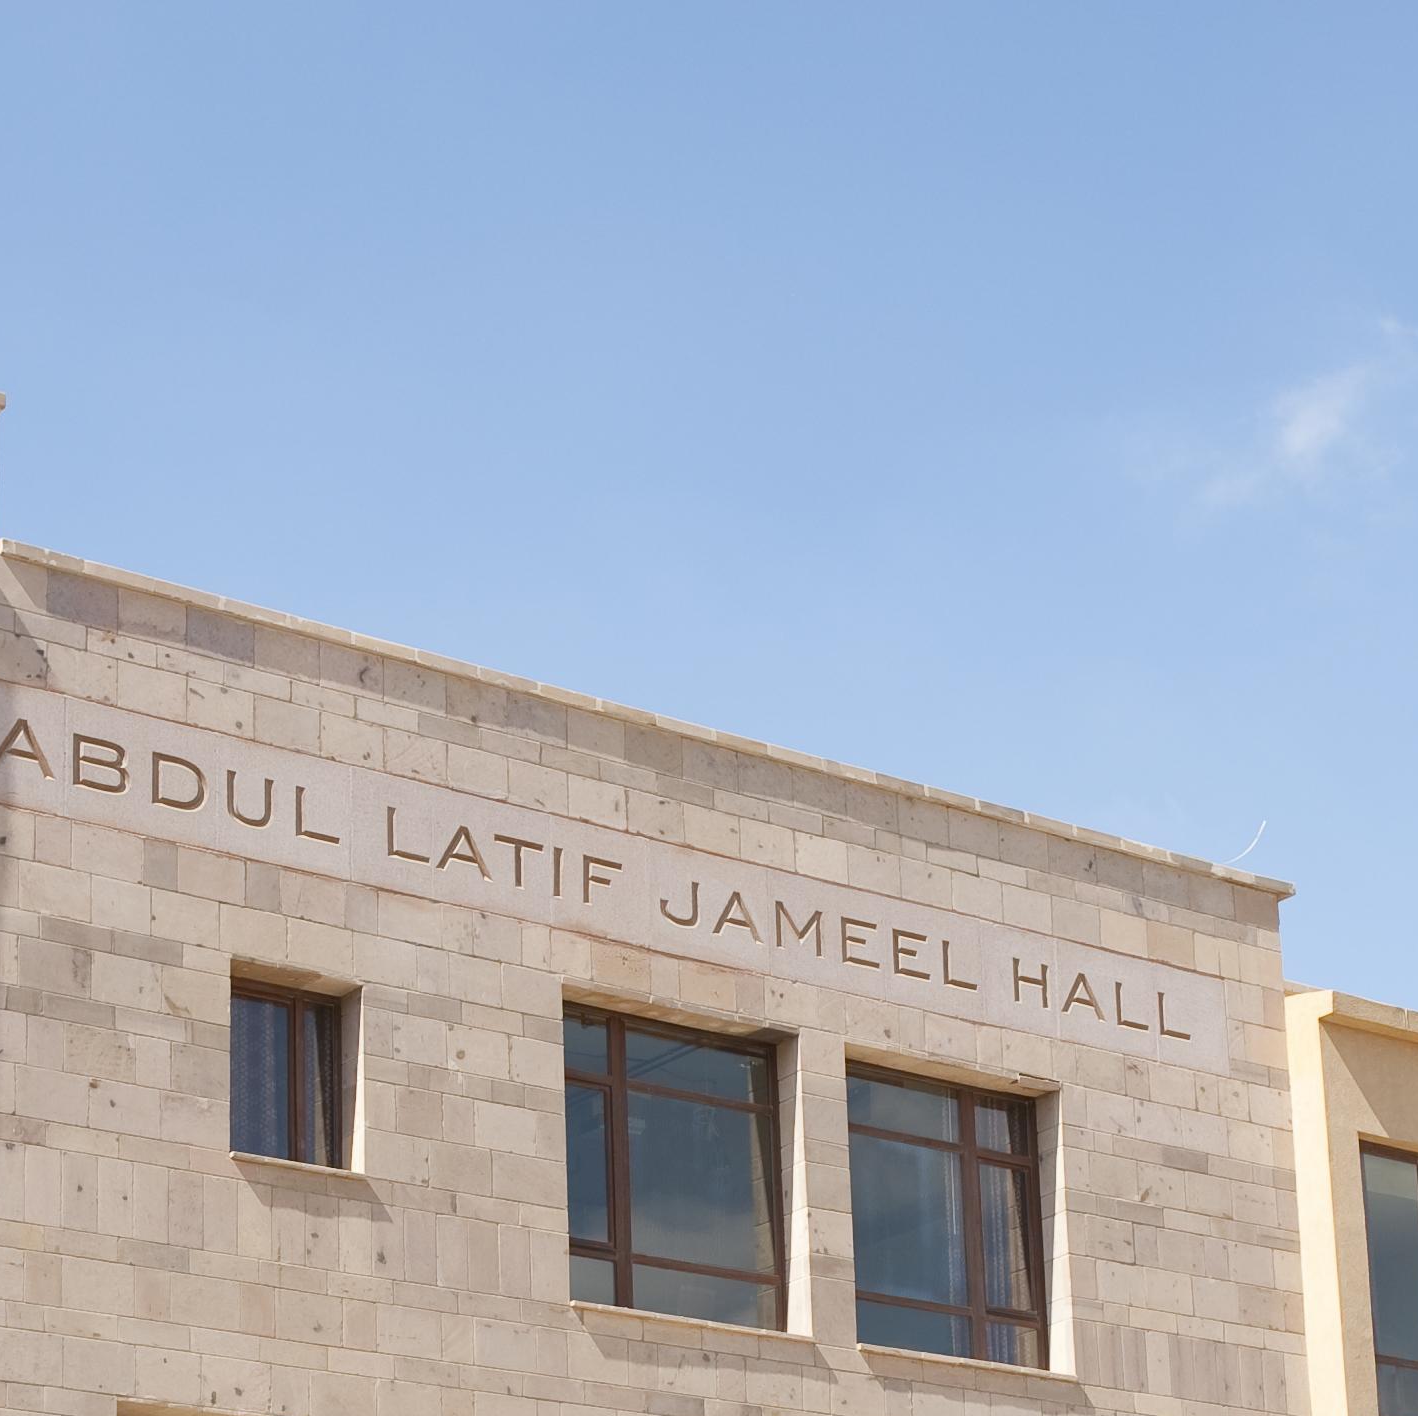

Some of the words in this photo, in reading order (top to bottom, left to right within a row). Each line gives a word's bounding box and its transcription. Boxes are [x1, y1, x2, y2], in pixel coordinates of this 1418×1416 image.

[387, 807, 623, 903] LATIF
[661, 881, 978, 991] JAMEEL
[1012, 957, 1192, 1040] HALL
